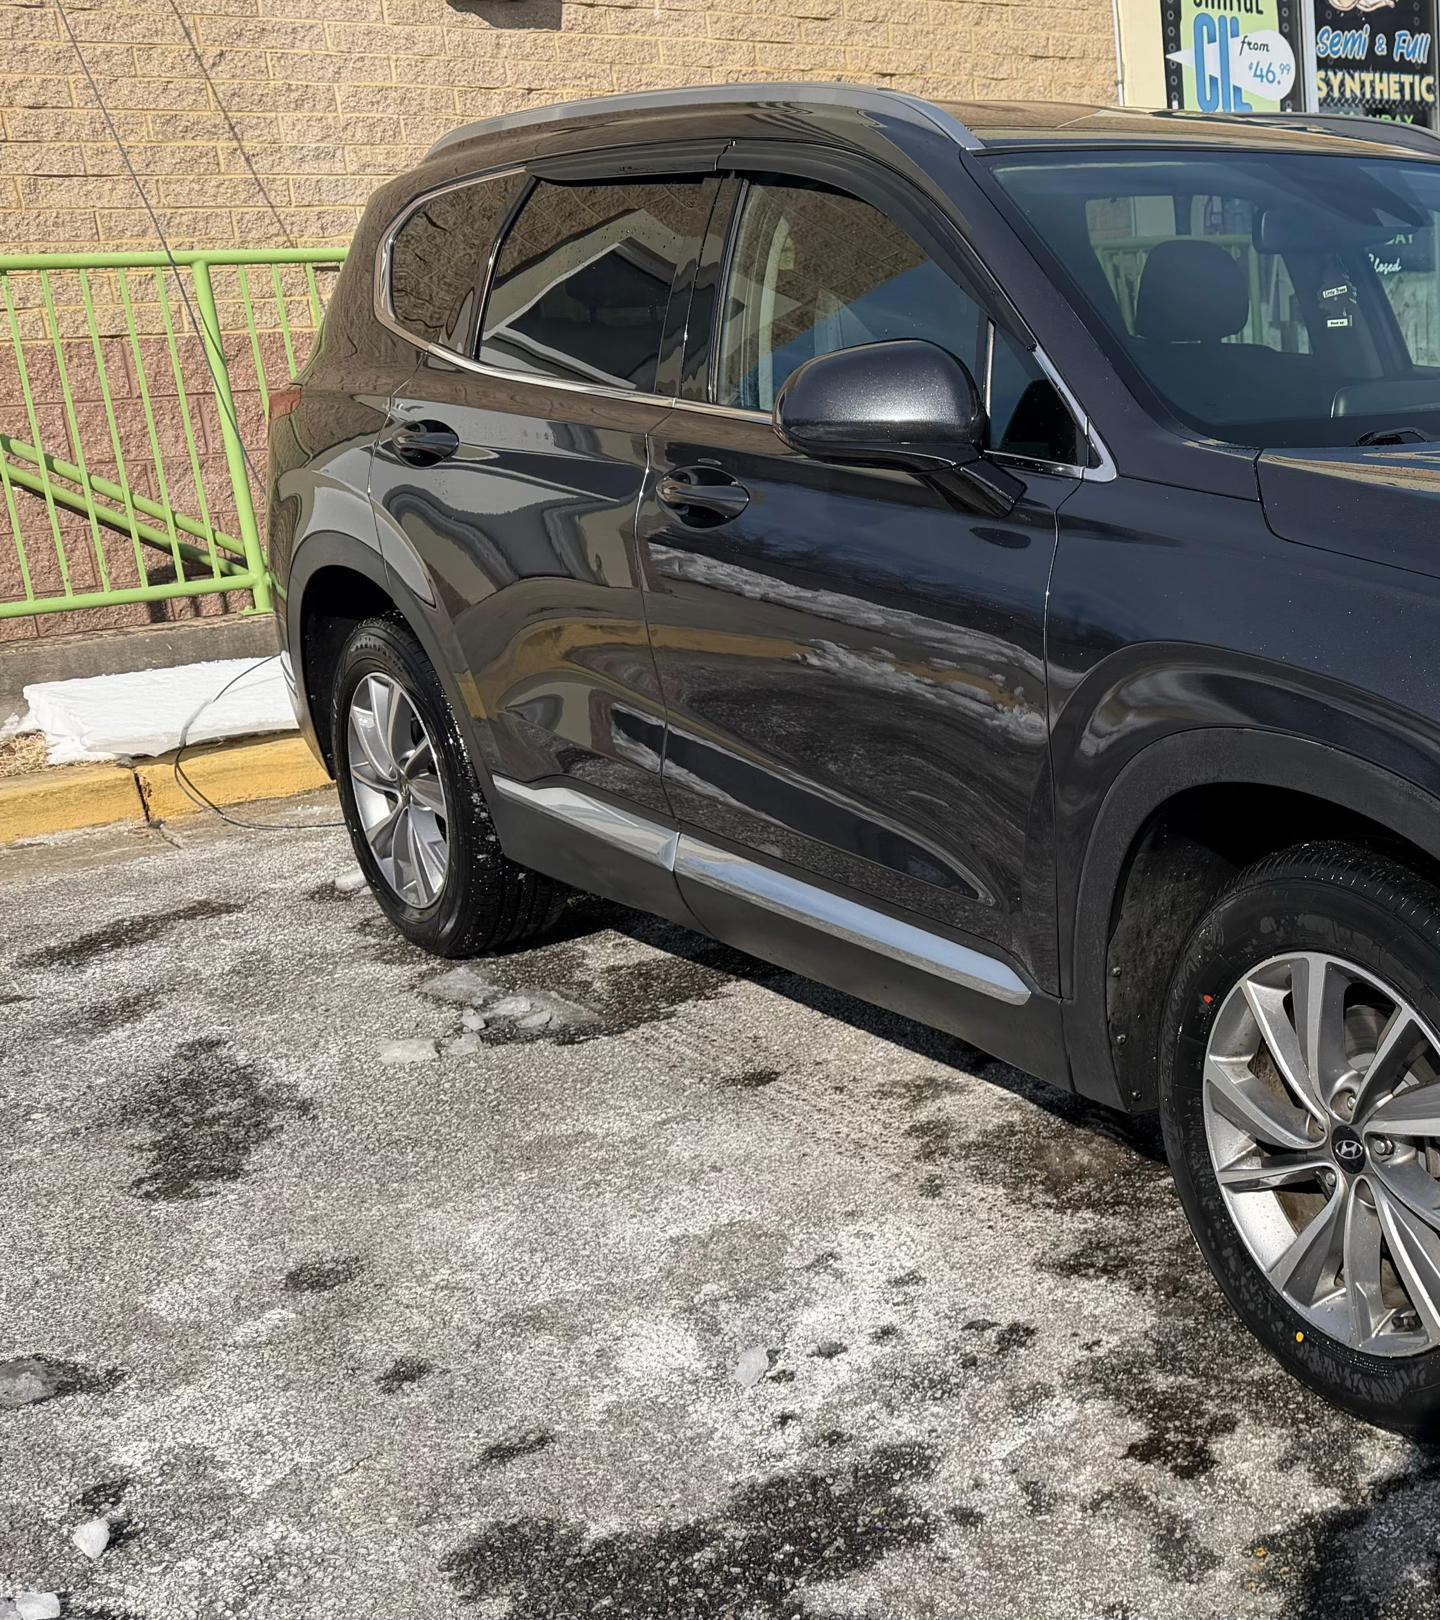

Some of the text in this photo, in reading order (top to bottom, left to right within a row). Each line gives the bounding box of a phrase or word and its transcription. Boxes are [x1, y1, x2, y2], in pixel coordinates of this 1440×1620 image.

[1240, 35, 1270, 56] from
[1316, 23, 1431, 64] Semi & Full
[1316, 69, 1436, 102] SYNTHETIC
